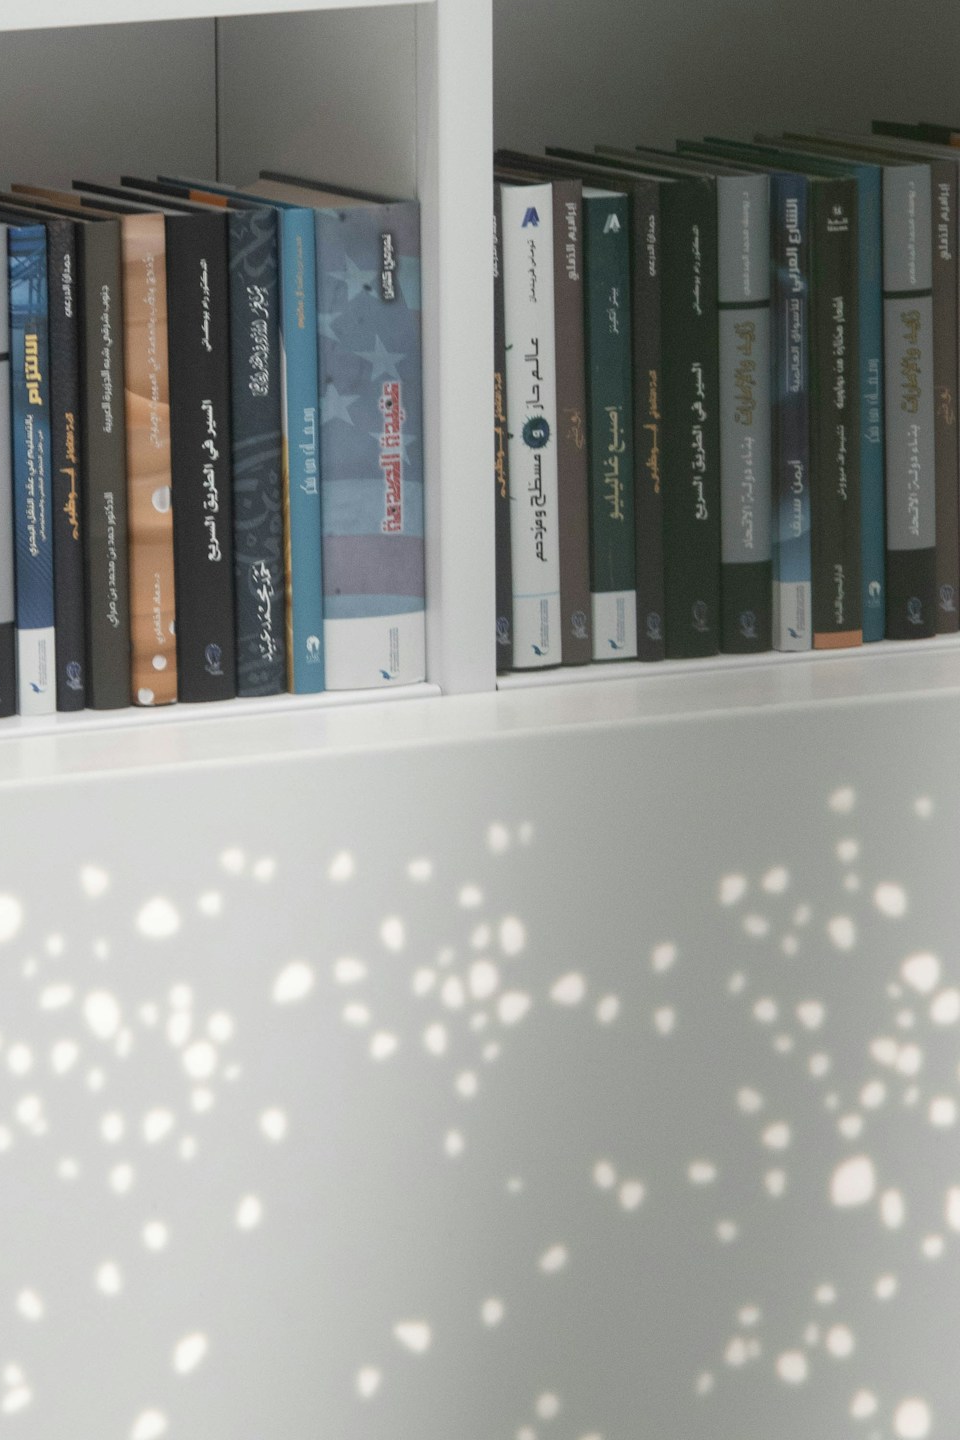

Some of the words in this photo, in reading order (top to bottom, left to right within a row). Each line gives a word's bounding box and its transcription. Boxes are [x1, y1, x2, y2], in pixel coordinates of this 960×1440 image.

[201, 400, 216, 437] السير
[202, 440, 219, 460] في
[203, 464, 218, 512] الطريق
[204, 516, 221, 561] السريع
